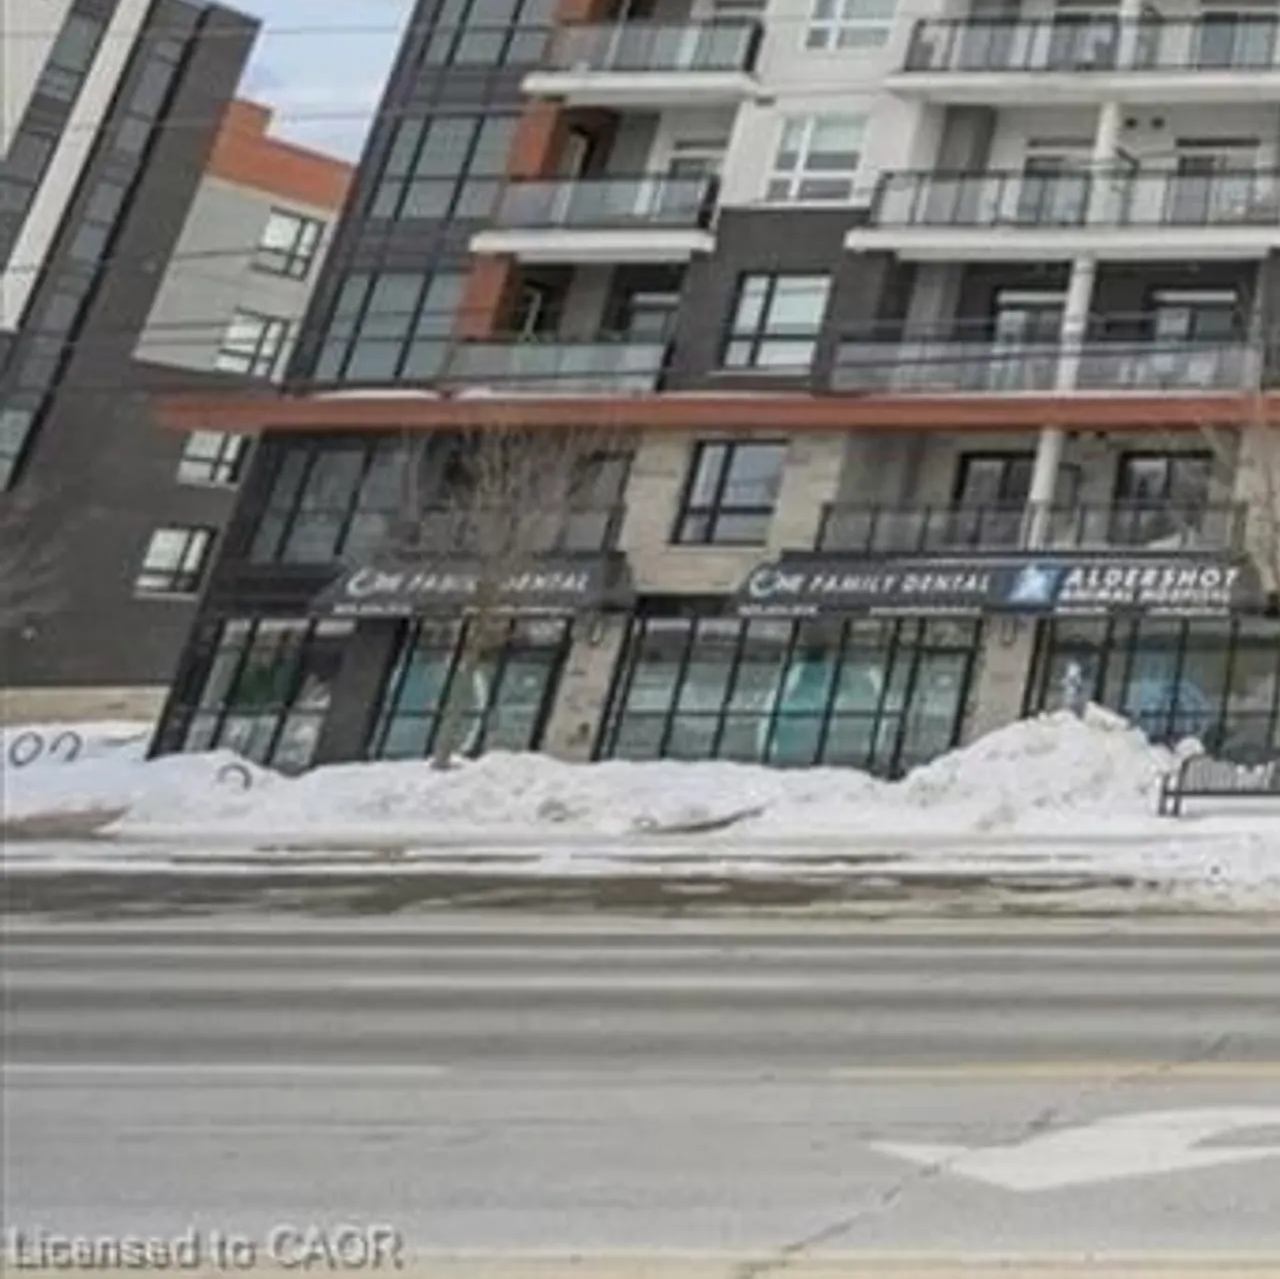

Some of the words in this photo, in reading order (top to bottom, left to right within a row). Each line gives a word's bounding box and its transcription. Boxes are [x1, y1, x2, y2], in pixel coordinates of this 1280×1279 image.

[808, 573, 896, 594] FAMILY
[901, 573, 990, 594] DENTAL
[1062, 567, 1241, 587] ALDERSHOT
